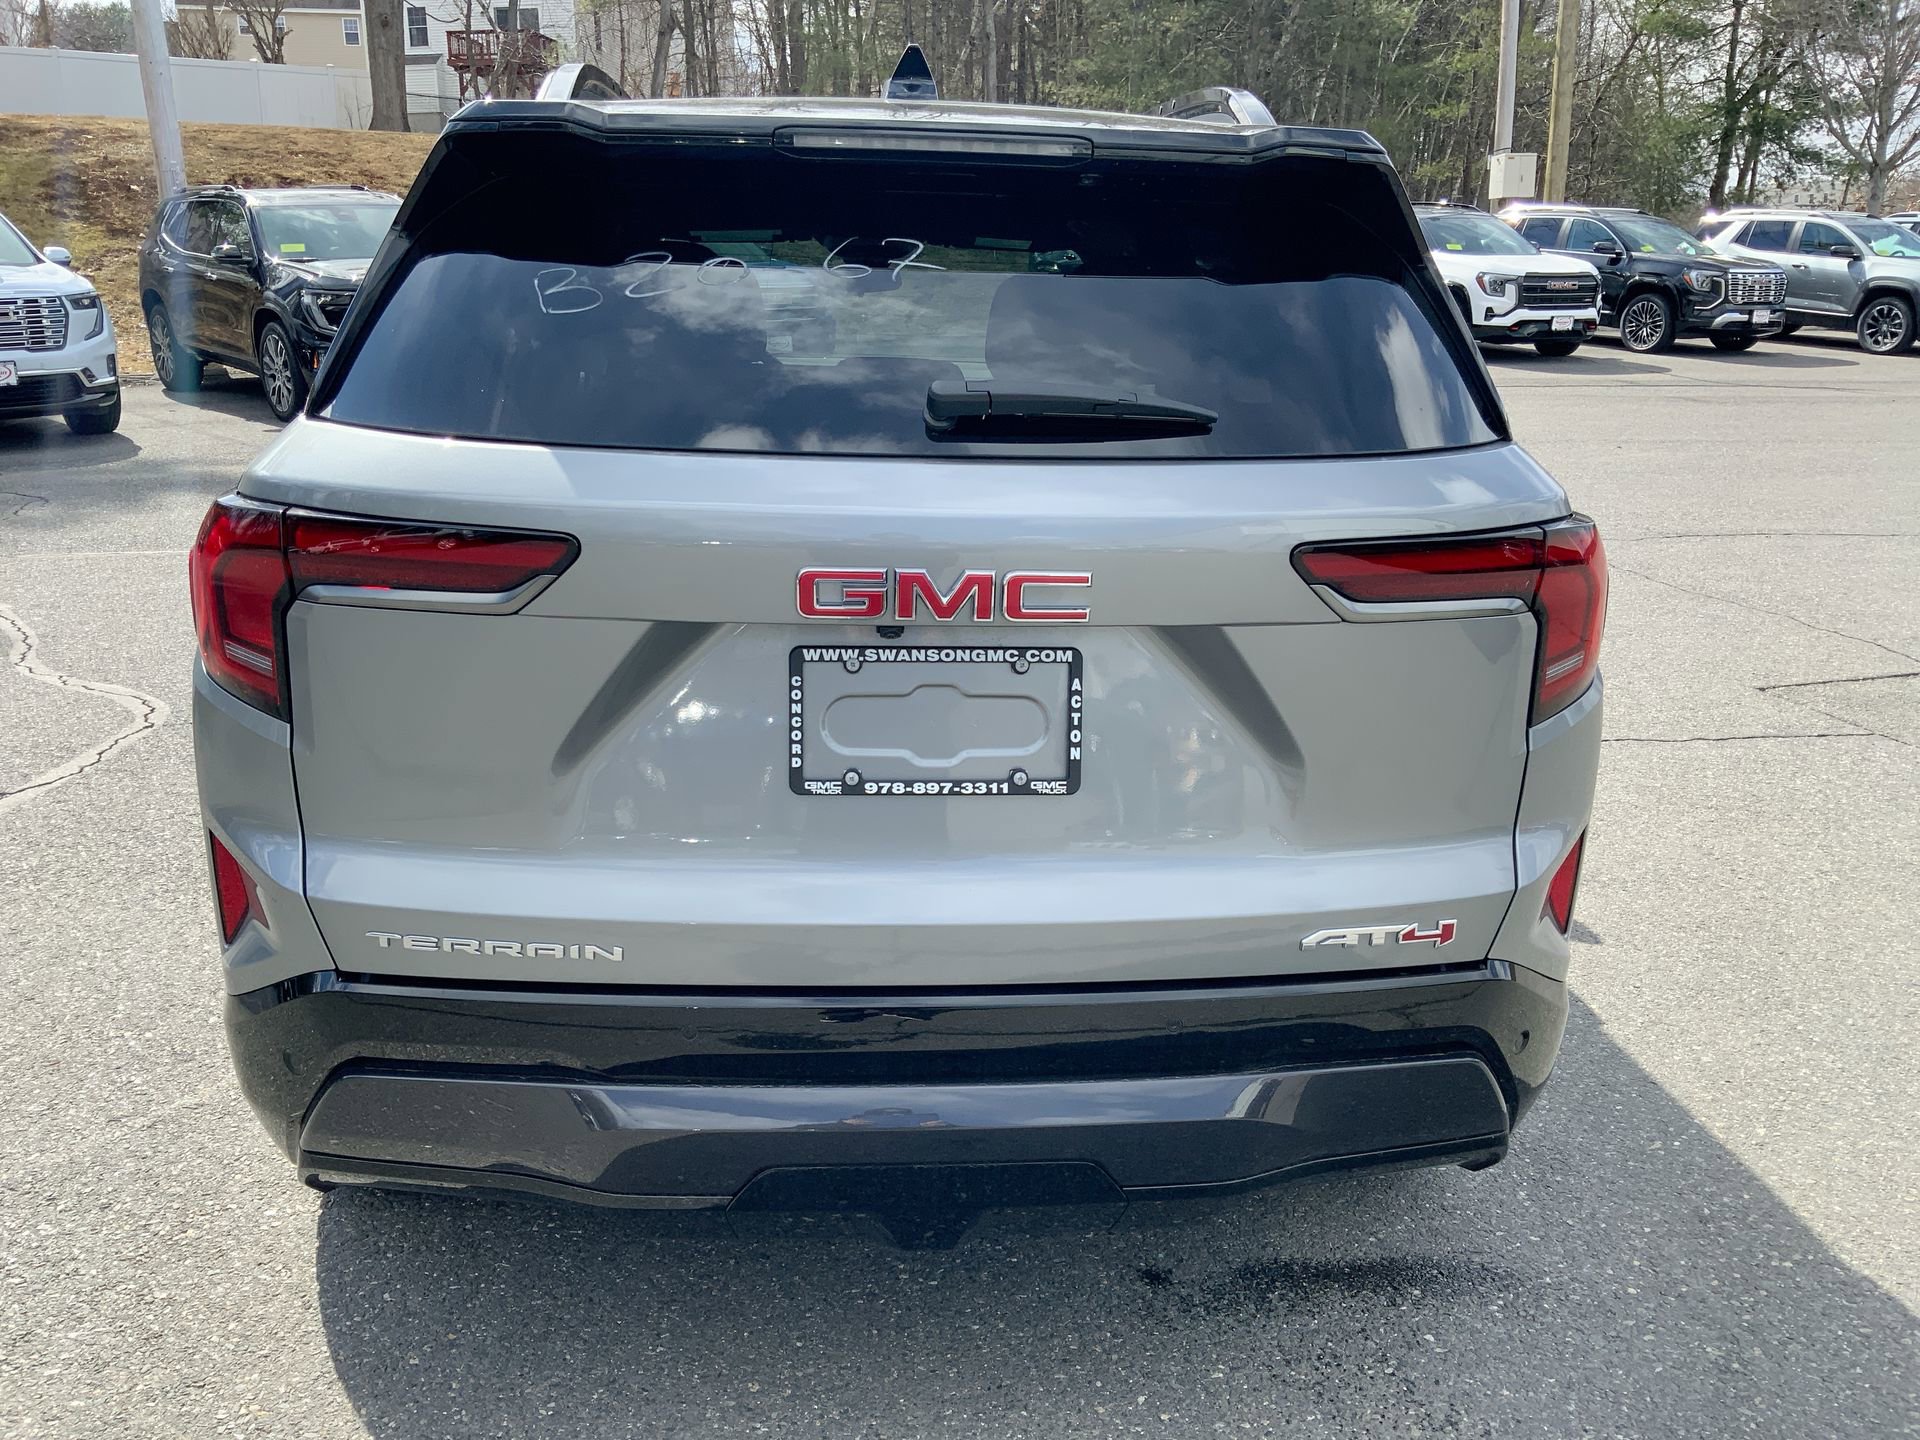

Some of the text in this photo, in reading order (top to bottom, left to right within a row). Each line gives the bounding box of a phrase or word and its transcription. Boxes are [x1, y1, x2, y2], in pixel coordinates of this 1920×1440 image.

[796, 566, 1093, 622] GMC
[802, 648, 1073, 663] WWW.SWANSONGMC.COM
[791, 676, 802, 768] CONCORD
[1070, 678, 1082, 760] ACTON
[804, 782, 842, 790] GMC
[864, 782, 1009, 795] 978-897-3311
[1030, 781, 1067, 789] GMC
[365, 931, 624, 962] TERRAIN
[1299, 918, 1458, 951] AT4
